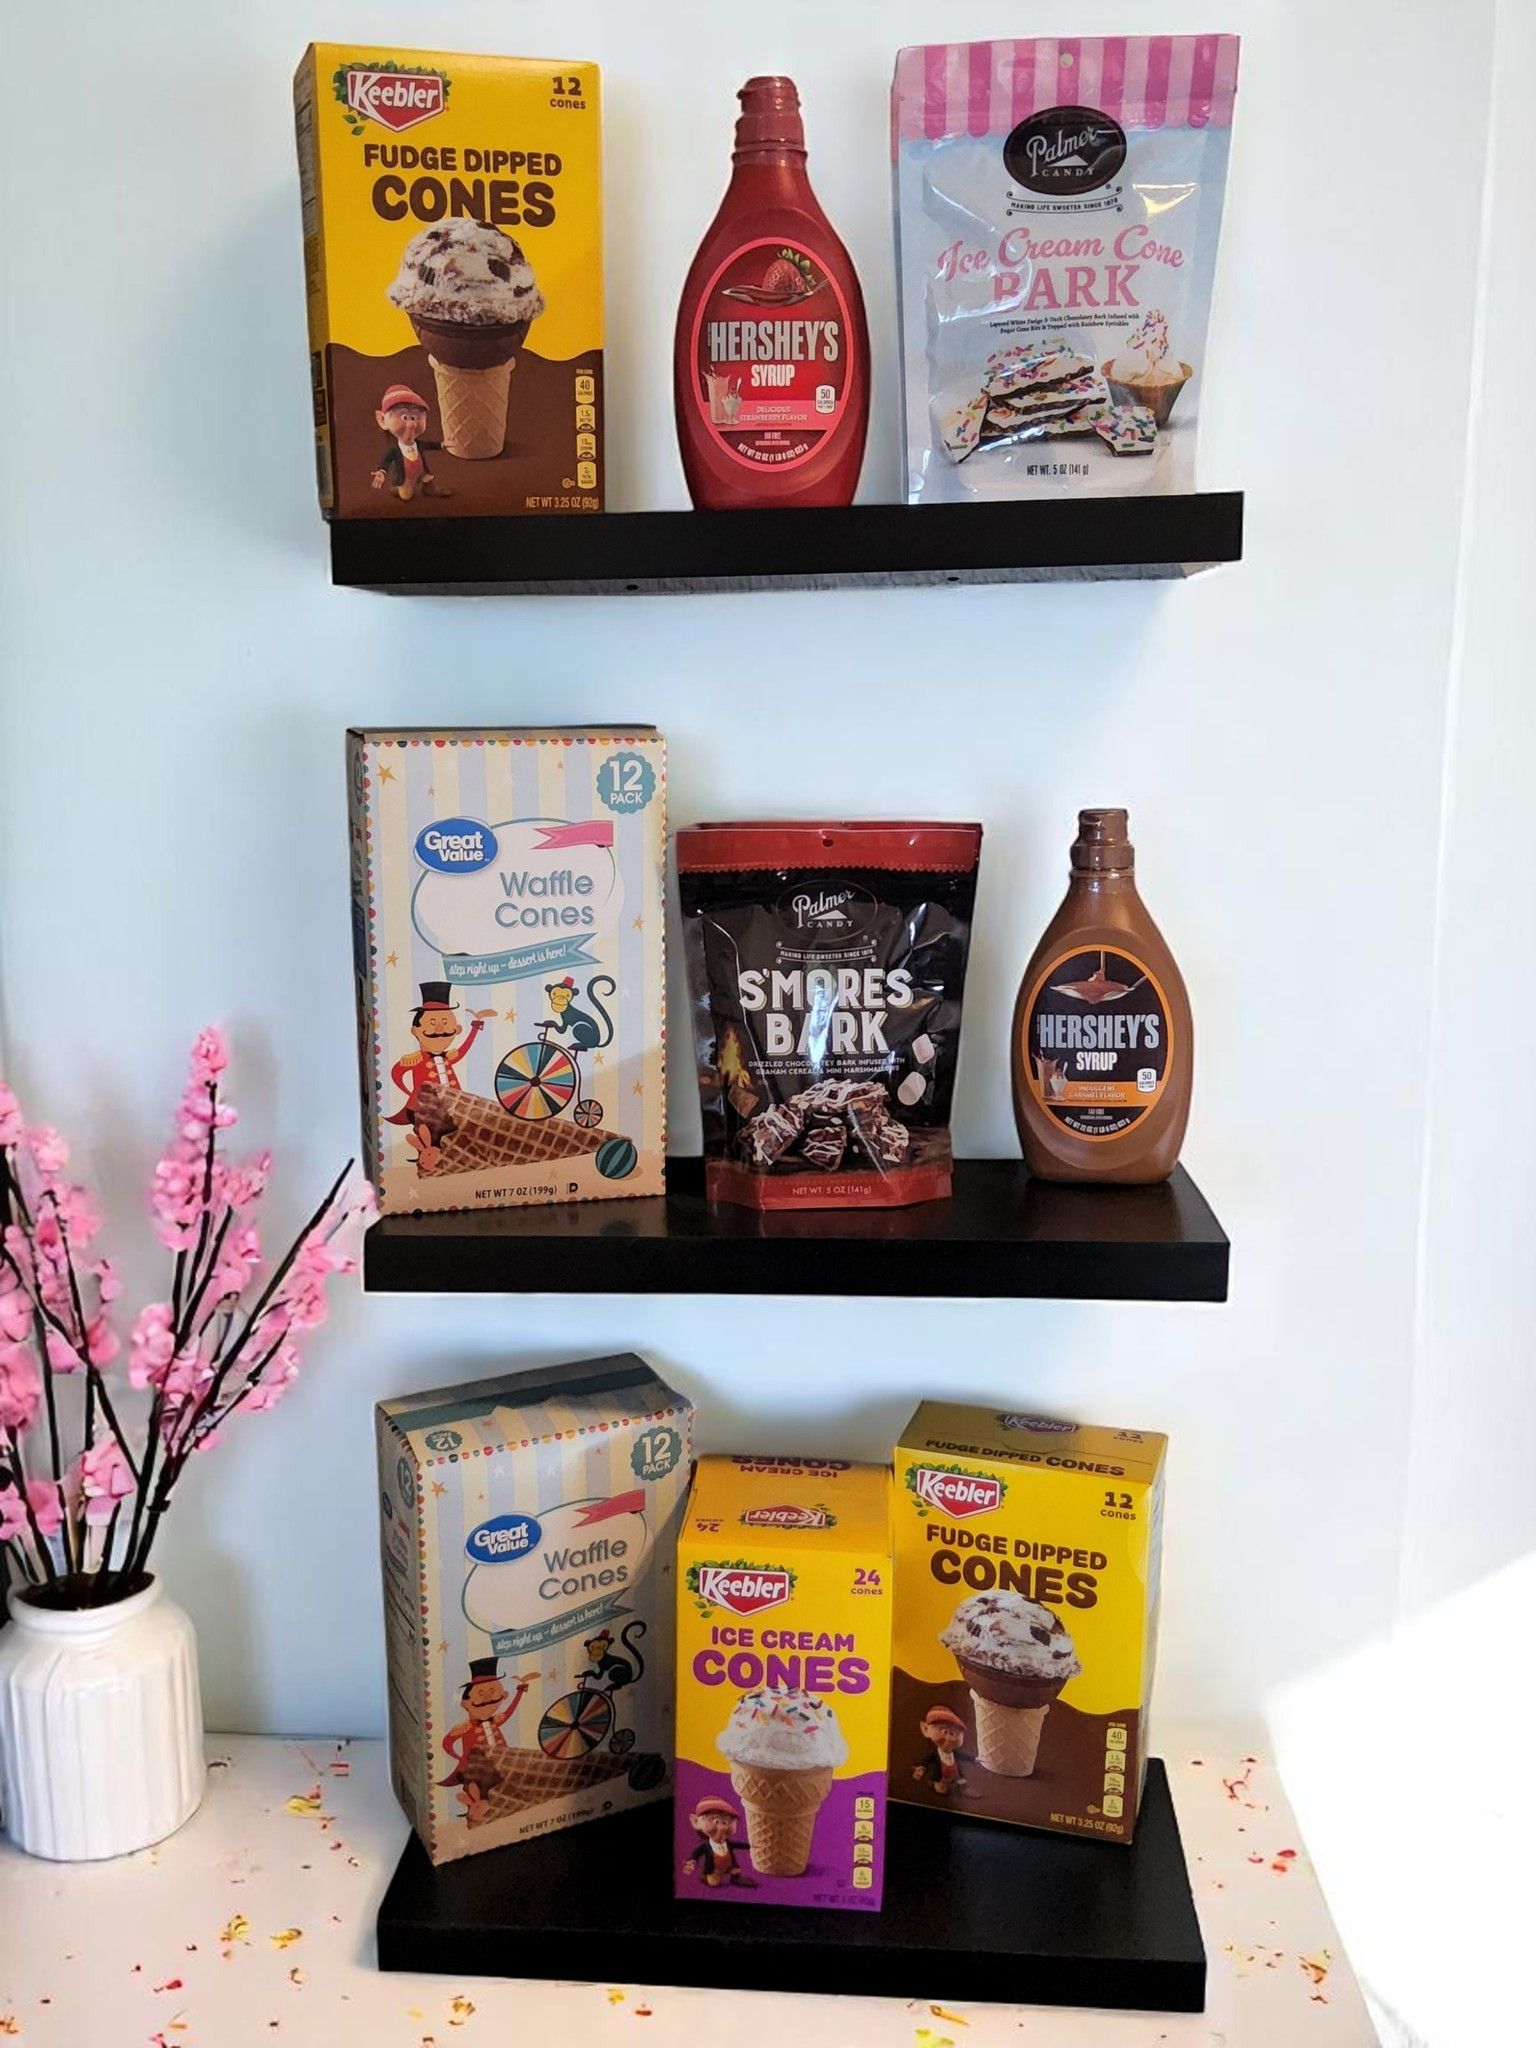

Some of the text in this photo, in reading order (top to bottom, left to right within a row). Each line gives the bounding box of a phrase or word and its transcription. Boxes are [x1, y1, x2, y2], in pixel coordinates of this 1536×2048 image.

[351, 72, 439, 111] Keebler
[552, 76, 582, 96] 12
[549, 98, 586, 110] cones
[363, 143, 562, 177] FUDGE DIPPED
[1026, 125, 1098, 177] Palmer
[1042, 167, 1096, 177] CANDY
[372, 174, 556, 228] CONES
[1010, 202, 1035, 210] MAKING
[1083, 202, 1102, 210] SINCE
[937, 223, 1185, 283] Ice Cream Cone
[992, 264, 1141, 314] BARK
[999, 327, 1016, 335] Sugar
[1047, 323, 1067, 331] Topped
[1105, 319, 1130, 328] Sprinkles
[710, 319, 839, 363] HERSHEY'S
[579, 379, 591, 391] 40
[750, 364, 796, 388] SYRUP
[819, 388, 832, 400] 50
[738, 413, 808, 421] STRAWBERRY FLAVOR
[1026, 464, 1038, 476] NET
[1052, 464, 1058, 475] 5
[1059, 464, 1067, 475] OZ
[1068, 464, 1081, 476] (141
[526, 496, 600, 510] NET WT 3.25 OZ (92g)
[609, 759, 643, 791] 12
[610, 792, 643, 804] PACK
[424, 831, 484, 850] Great
[438, 848, 484, 863] Value
[499, 870, 594, 898] Waffle
[494, 902, 595, 928] Cones
[792, 888, 856, 929] Palmer
[807, 920, 854, 928] CANDY
[448, 944, 567, 977] step right up dessert is here!
[780, 950, 802, 959] MAKING
[816, 952, 842, 960] SWEETER
[843, 950, 860, 958] SINCE
[738, 967, 915, 1012] S'MORES
[1039, 1013, 1160, 1050] HERSHEY'S
[748, 1060, 783, 1068] DRIZZLED
[858, 1058, 886, 1066] INFUSED
[1076, 1051, 1118, 1072] SYRUP
[755, 1067, 787, 1076] GRAHAM
[1142, 1071, 1152, 1081] 50
[475, 1185, 558, 1199] NET WT 7 OZ (199g)
[792, 1186, 808, 1195] NET
[826, 1186, 832, 1194] 5
[833, 1185, 846, 1194] OZ
[1010, 1415, 1072, 1433] Keebler
[641, 1432, 673, 1464] 12
[925, 1438, 1125, 1477] FUDGE DIPPED CONES
[642, 1460, 671, 1474] PACK
[739, 1464, 838, 1479] ICE CREAM
[919, 1471, 998, 1506] Keebler
[1104, 1491, 1133, 1510] 12
[752, 1509, 824, 1526] Keebler
[1100, 1507, 1136, 1521] cones
[474, 1522, 529, 1548] Great
[696, 1523, 721, 1532] 24
[486, 1536, 529, 1556] Value
[926, 1523, 1108, 1571] FUDGE DIPPED
[543, 1538, 628, 1574] Waffle
[538, 1564, 629, 1600] Cones
[702, 1569, 786, 1603] Keebler
[853, 1568, 881, 1586] 24
[930, 1549, 1098, 1609] CONES
[850, 1587, 883, 1596] cones
[531, 1632, 544, 1643] up
[712, 1626, 855, 1652] ICE CREAM
[692, 1649, 871, 1695] CONES
[1111, 1731, 1123, 1740] 40
[860, 1799, 870, 1808] 15
[519, 1824, 535, 1835] NET
[535, 1820, 549, 1830] WT
[556, 1814, 567, 1824] OZ
[1050, 1812, 1124, 1835] NET WT 3.25 OZ (92g)
